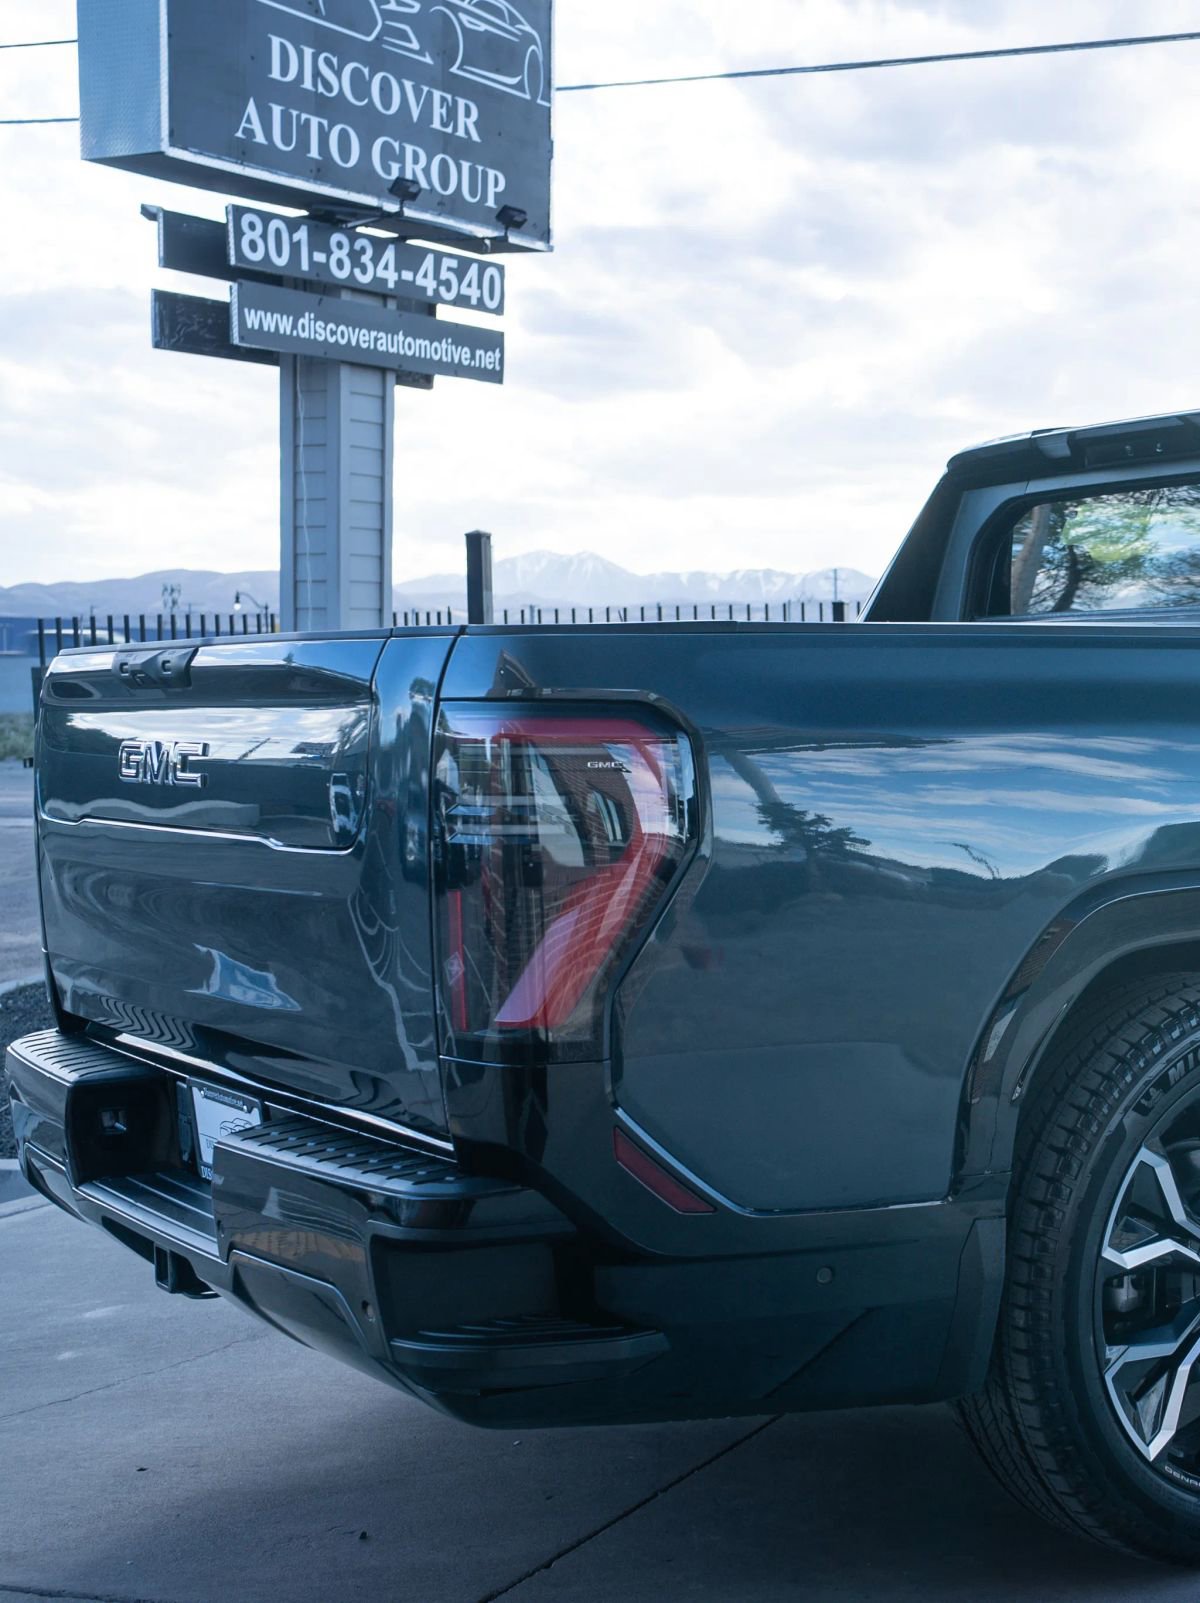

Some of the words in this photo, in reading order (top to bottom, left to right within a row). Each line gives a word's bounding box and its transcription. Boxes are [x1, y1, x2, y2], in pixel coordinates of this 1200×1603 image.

[267, 33, 481, 142] DISCOVER
[234, 96, 360, 168] AUTO
[371, 136, 506, 208] GROUP
[241, 213, 501, 310] 801-834-4540
[244, 307, 501, 372] www.discoverautomotive.net
[119, 740, 210, 788] GMC
[587, 761, 624, 769] GMC
